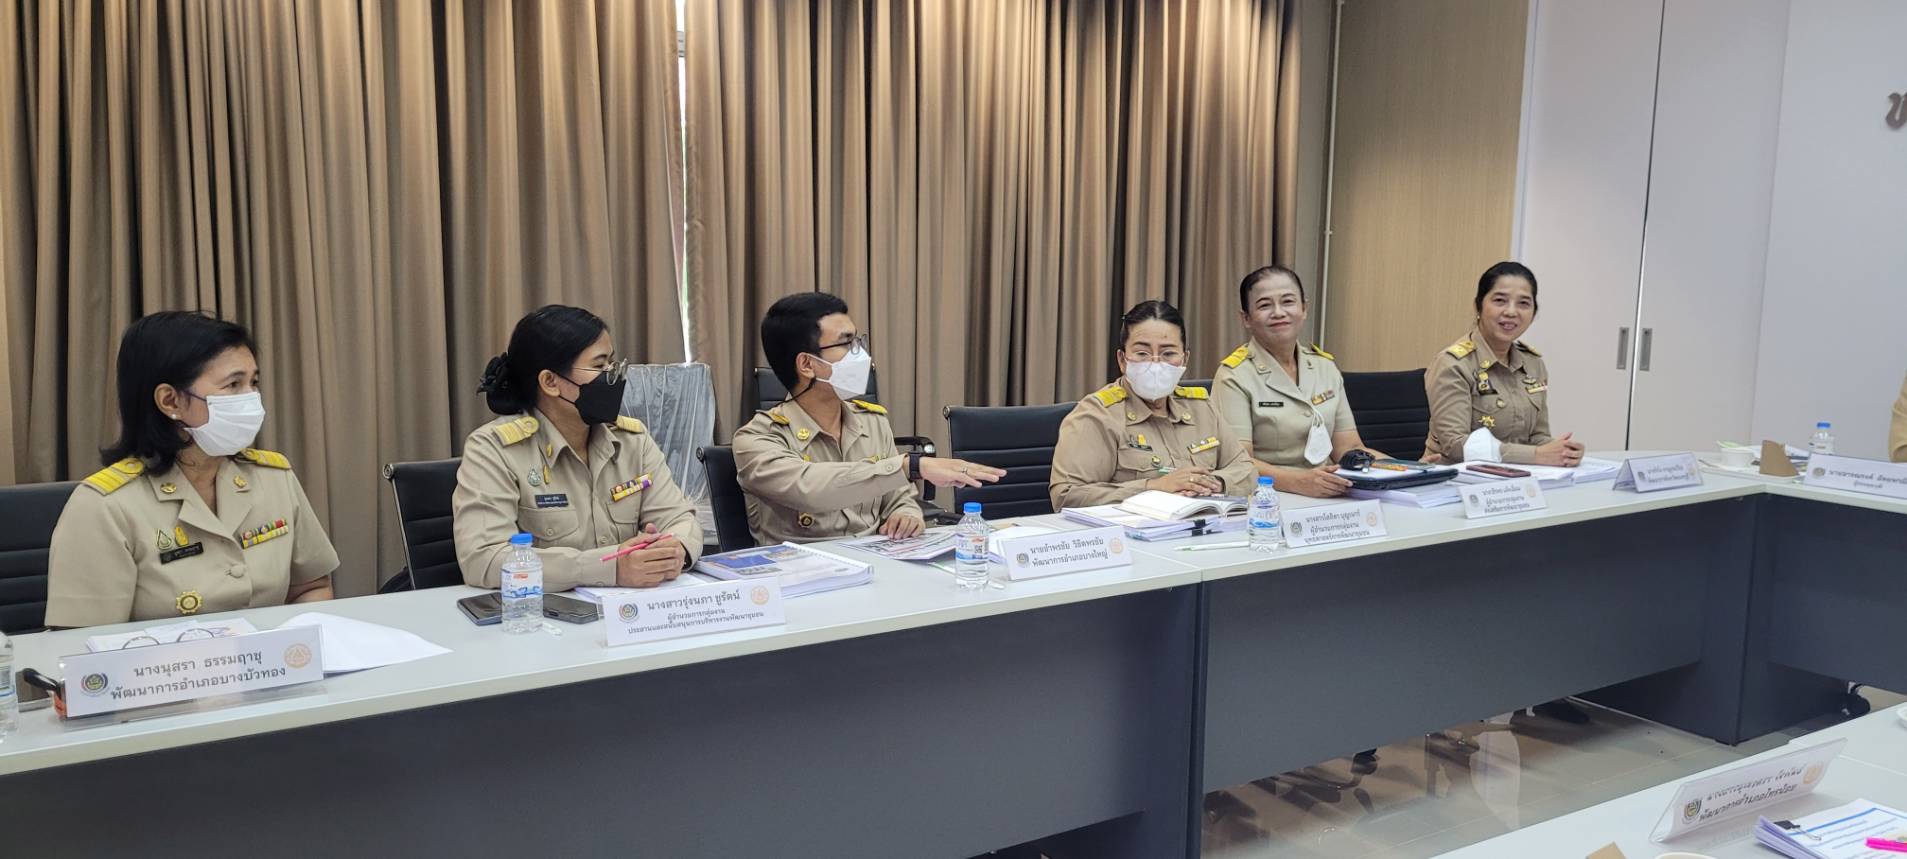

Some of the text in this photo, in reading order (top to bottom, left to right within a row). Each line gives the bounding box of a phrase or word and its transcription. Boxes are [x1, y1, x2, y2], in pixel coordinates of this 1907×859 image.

[647, 593, 713, 610] นางสาวรุ่งนภา
[133, 659, 196, 678] นางนุสรา
[111, 667, 287, 700] พัฒนาการอำเภอบางบัวทอง
